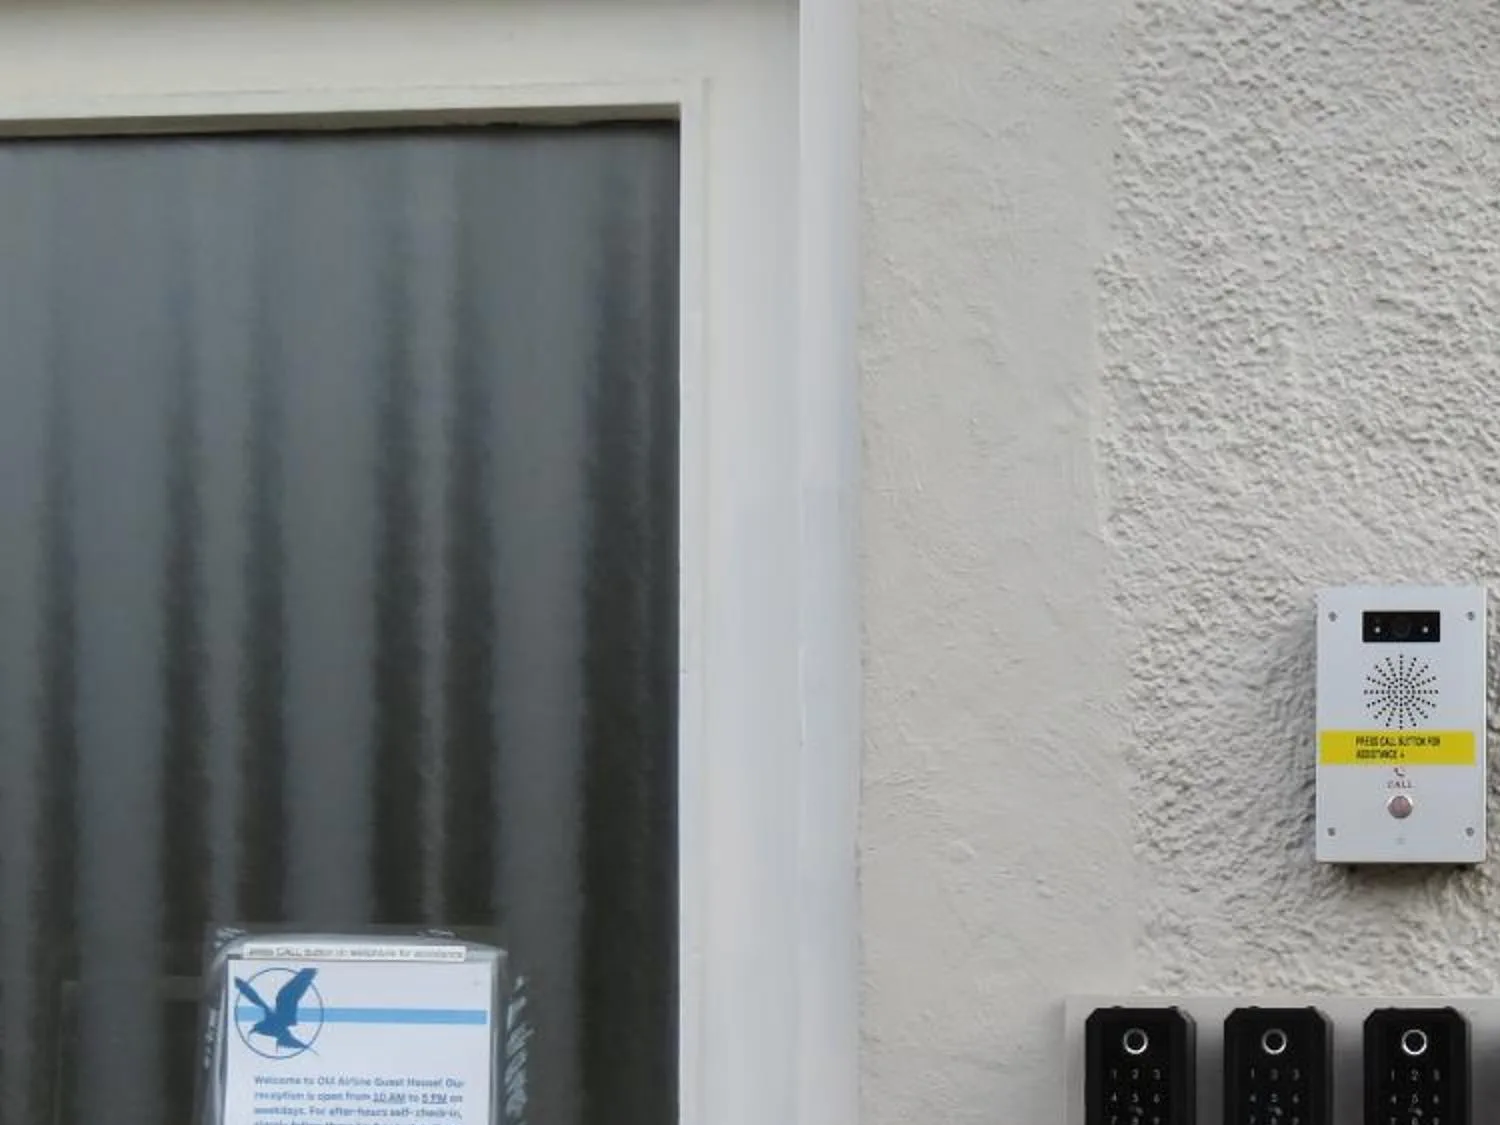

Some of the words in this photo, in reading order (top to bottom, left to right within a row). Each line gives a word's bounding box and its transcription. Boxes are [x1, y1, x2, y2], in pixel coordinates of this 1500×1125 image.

[1355, 736, 1379, 746] PRESS
[1380, 736, 1397, 746] CALL
[1398, 736, 1426, 746] BUTTON
[1427, 736, 1441, 746] FOR
[1355, 750, 1398, 759] ASSISTANCE
[1386, 780, 1413, 789] CALL
[254, 1075, 301, 1085] Welcome
[304, 1076, 315, 1086] to
[317, 1076, 335, 1086] Old
[338, 1076, 371, 1087] Airline
[374, 1077, 404, 1088] Guest
[445, 1078, 464, 1089] Our
[254, 1091, 304, 1102] reception
[317, 1092, 343, 1103] open
[346, 1092, 371, 1102] from
[388, 1093, 406, 1104] AM
[409, 1093, 420, 1103] to
[431, 1094, 448, 1105] PM
[450, 1095, 463, 1103] on
[309, 1106, 325, 1116] For
